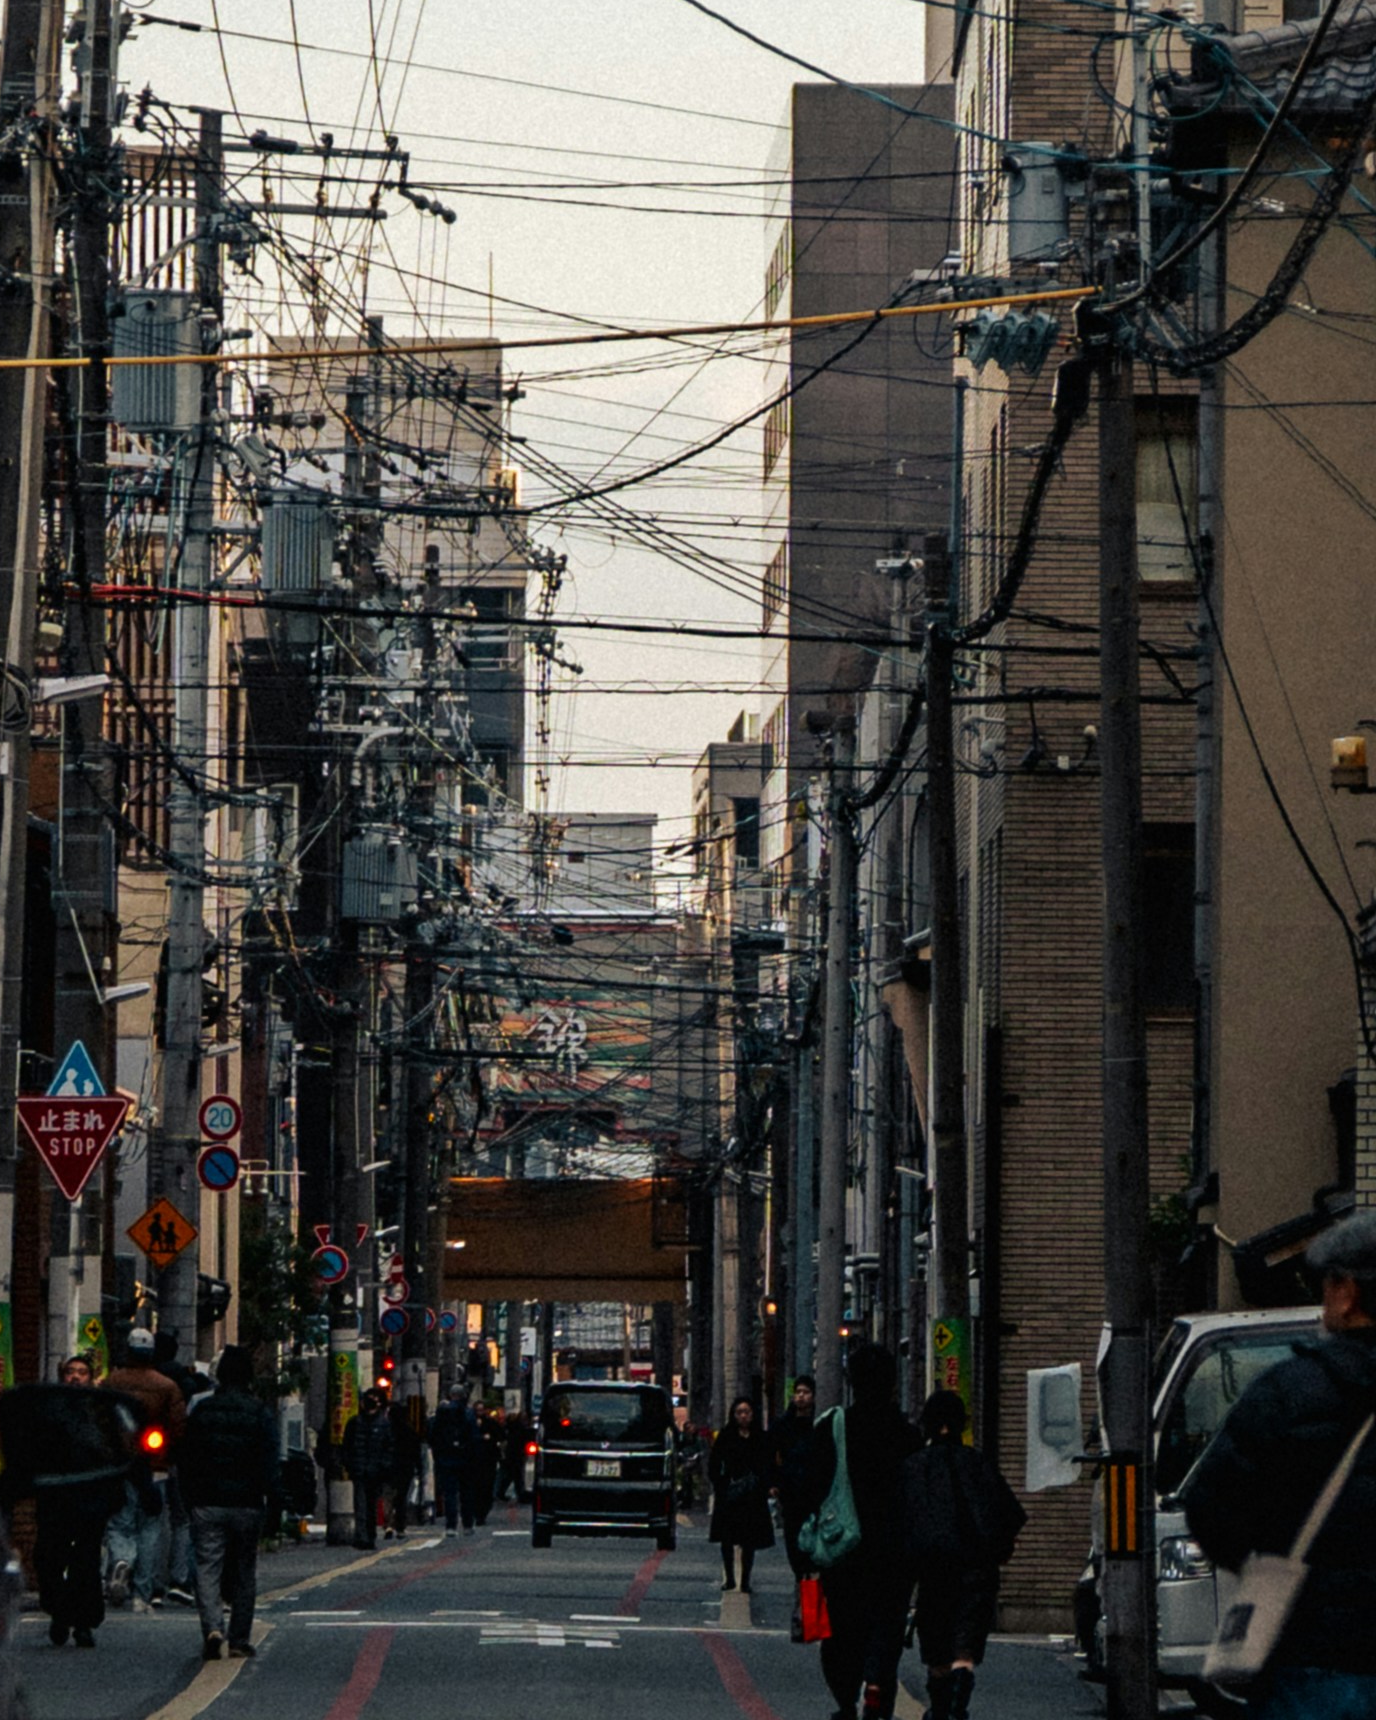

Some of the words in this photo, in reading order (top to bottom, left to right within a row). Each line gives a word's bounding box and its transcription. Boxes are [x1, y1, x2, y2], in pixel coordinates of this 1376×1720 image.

[37, 1108, 106, 1132] 止まれ
[207, 1106, 232, 1129] 20
[49, 1137, 96, 1156] STOP
